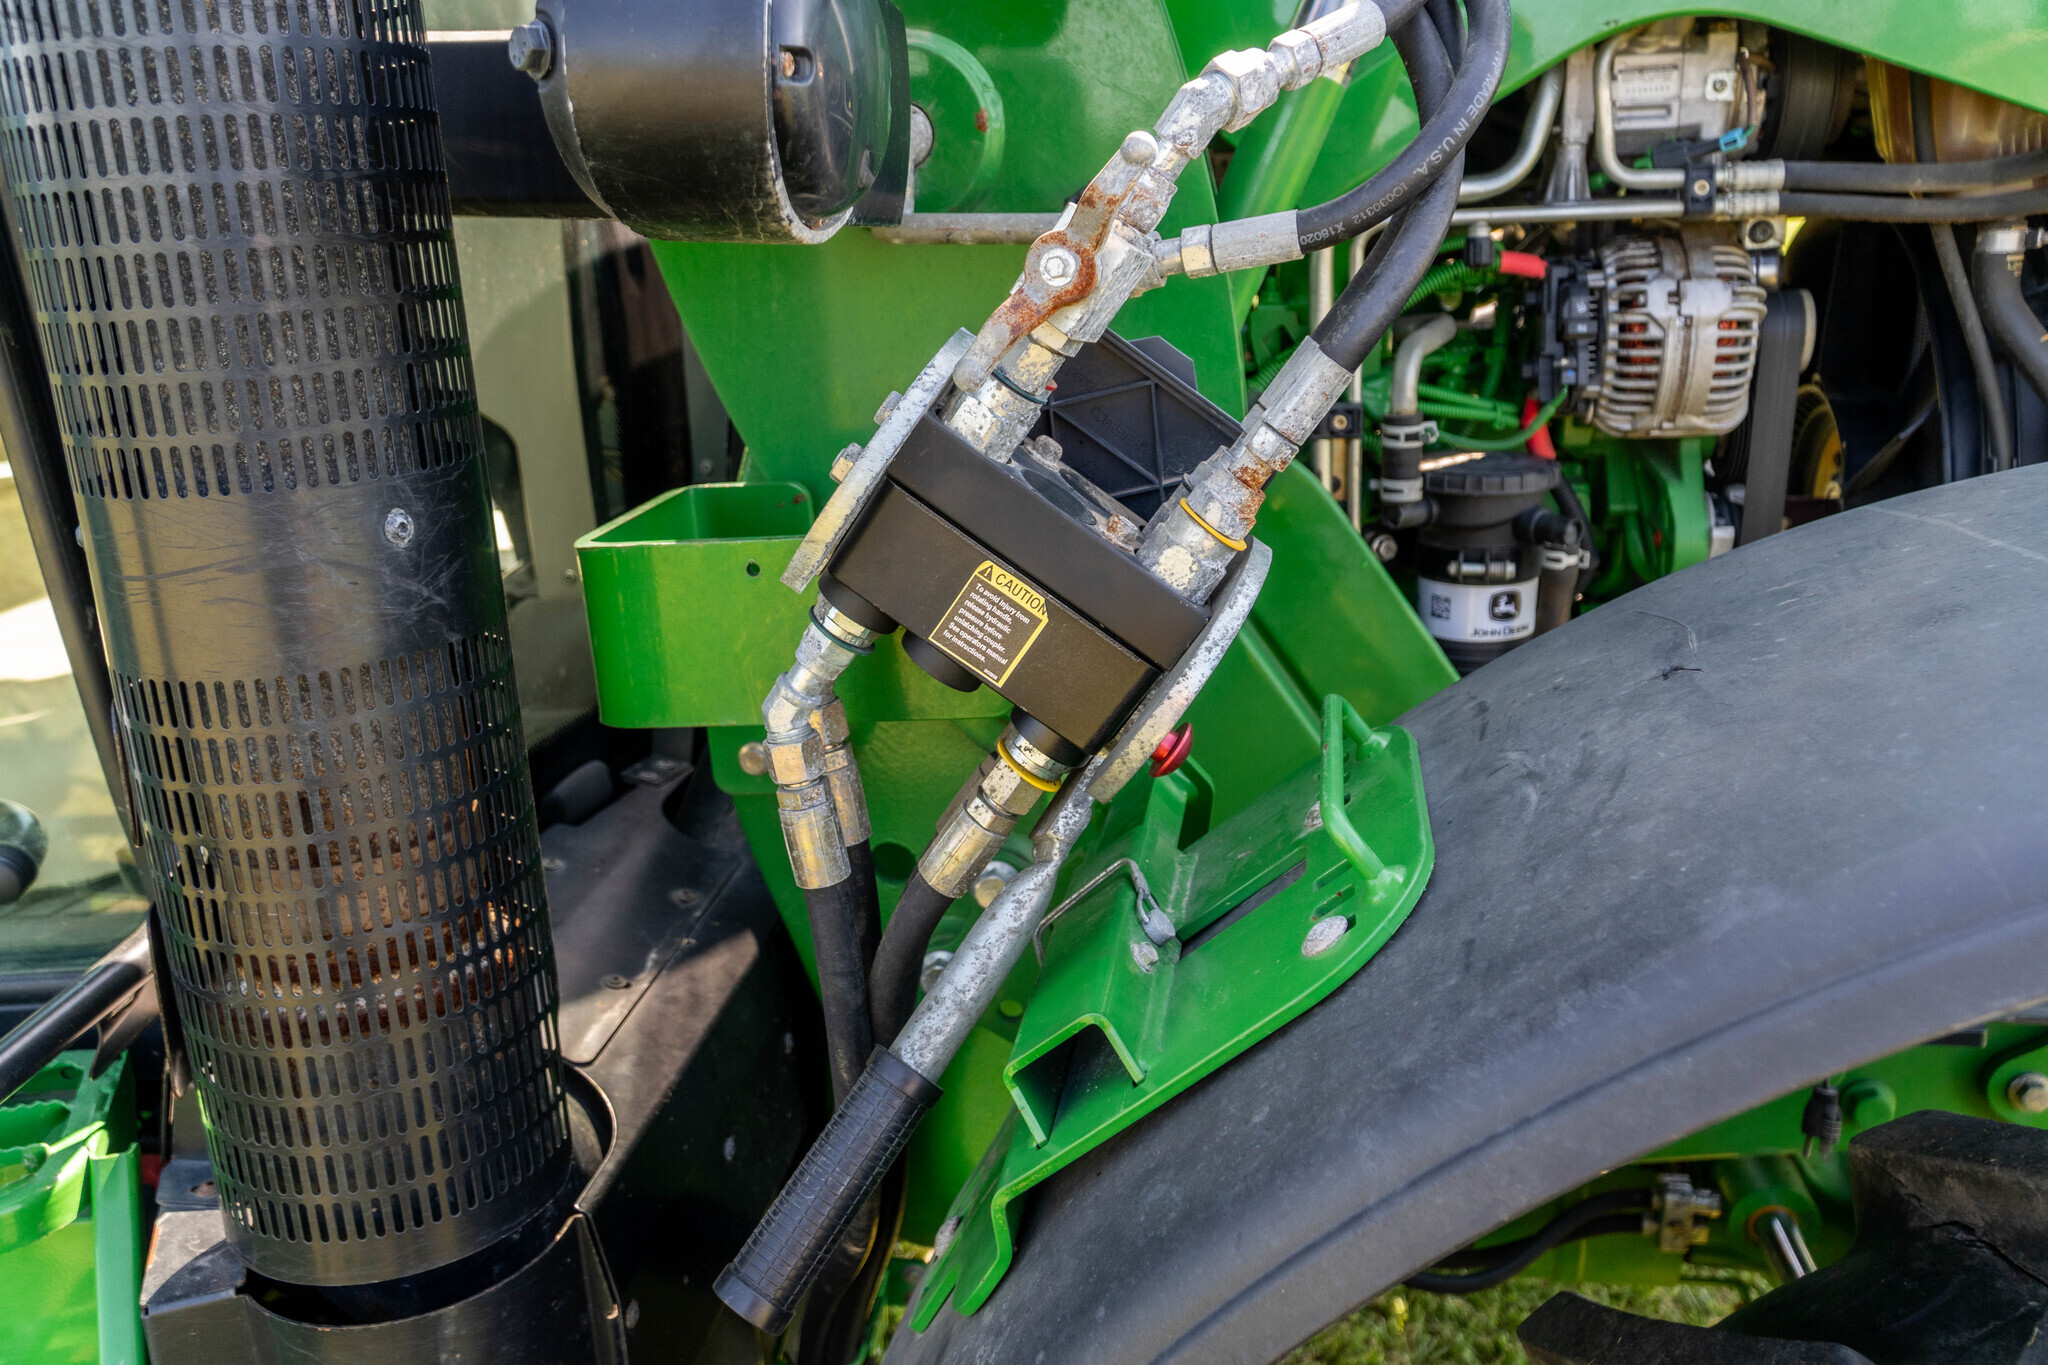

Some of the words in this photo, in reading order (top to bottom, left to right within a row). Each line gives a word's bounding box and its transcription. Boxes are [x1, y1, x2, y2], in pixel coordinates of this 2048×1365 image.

[1466, 73, 1497, 120] MADE
[1453, 121, 1470, 139] IN
[1413, 135, 1457, 177] U.S.A.
[1300, 221, 1346, 246] X18020
[970, 592, 992, 610] rotating
[992, 605, 1012, 624] handle,
[975, 583, 984, 592] To
[984, 588, 1000, 603] avoid
[1000, 599, 1016, 615] injury
[1016, 608, 1030, 624] from
[995, 573, 1046, 616] CAUTION
[958, 608, 984, 626] pressure
[964, 599, 985, 618] release
[984, 611, 1012, 634] hydraulic
[1472, 627, 1501, 637] JOHN
[943, 630, 952, 640] for
[951, 635, 986, 662] instructions.
[948, 622, 960, 633] See
[959, 629, 986, 651] operators
[987, 648, 1008, 665] manual
[954, 615, 984, 638] unlatching
[983, 635, 1006, 654] coupler.
